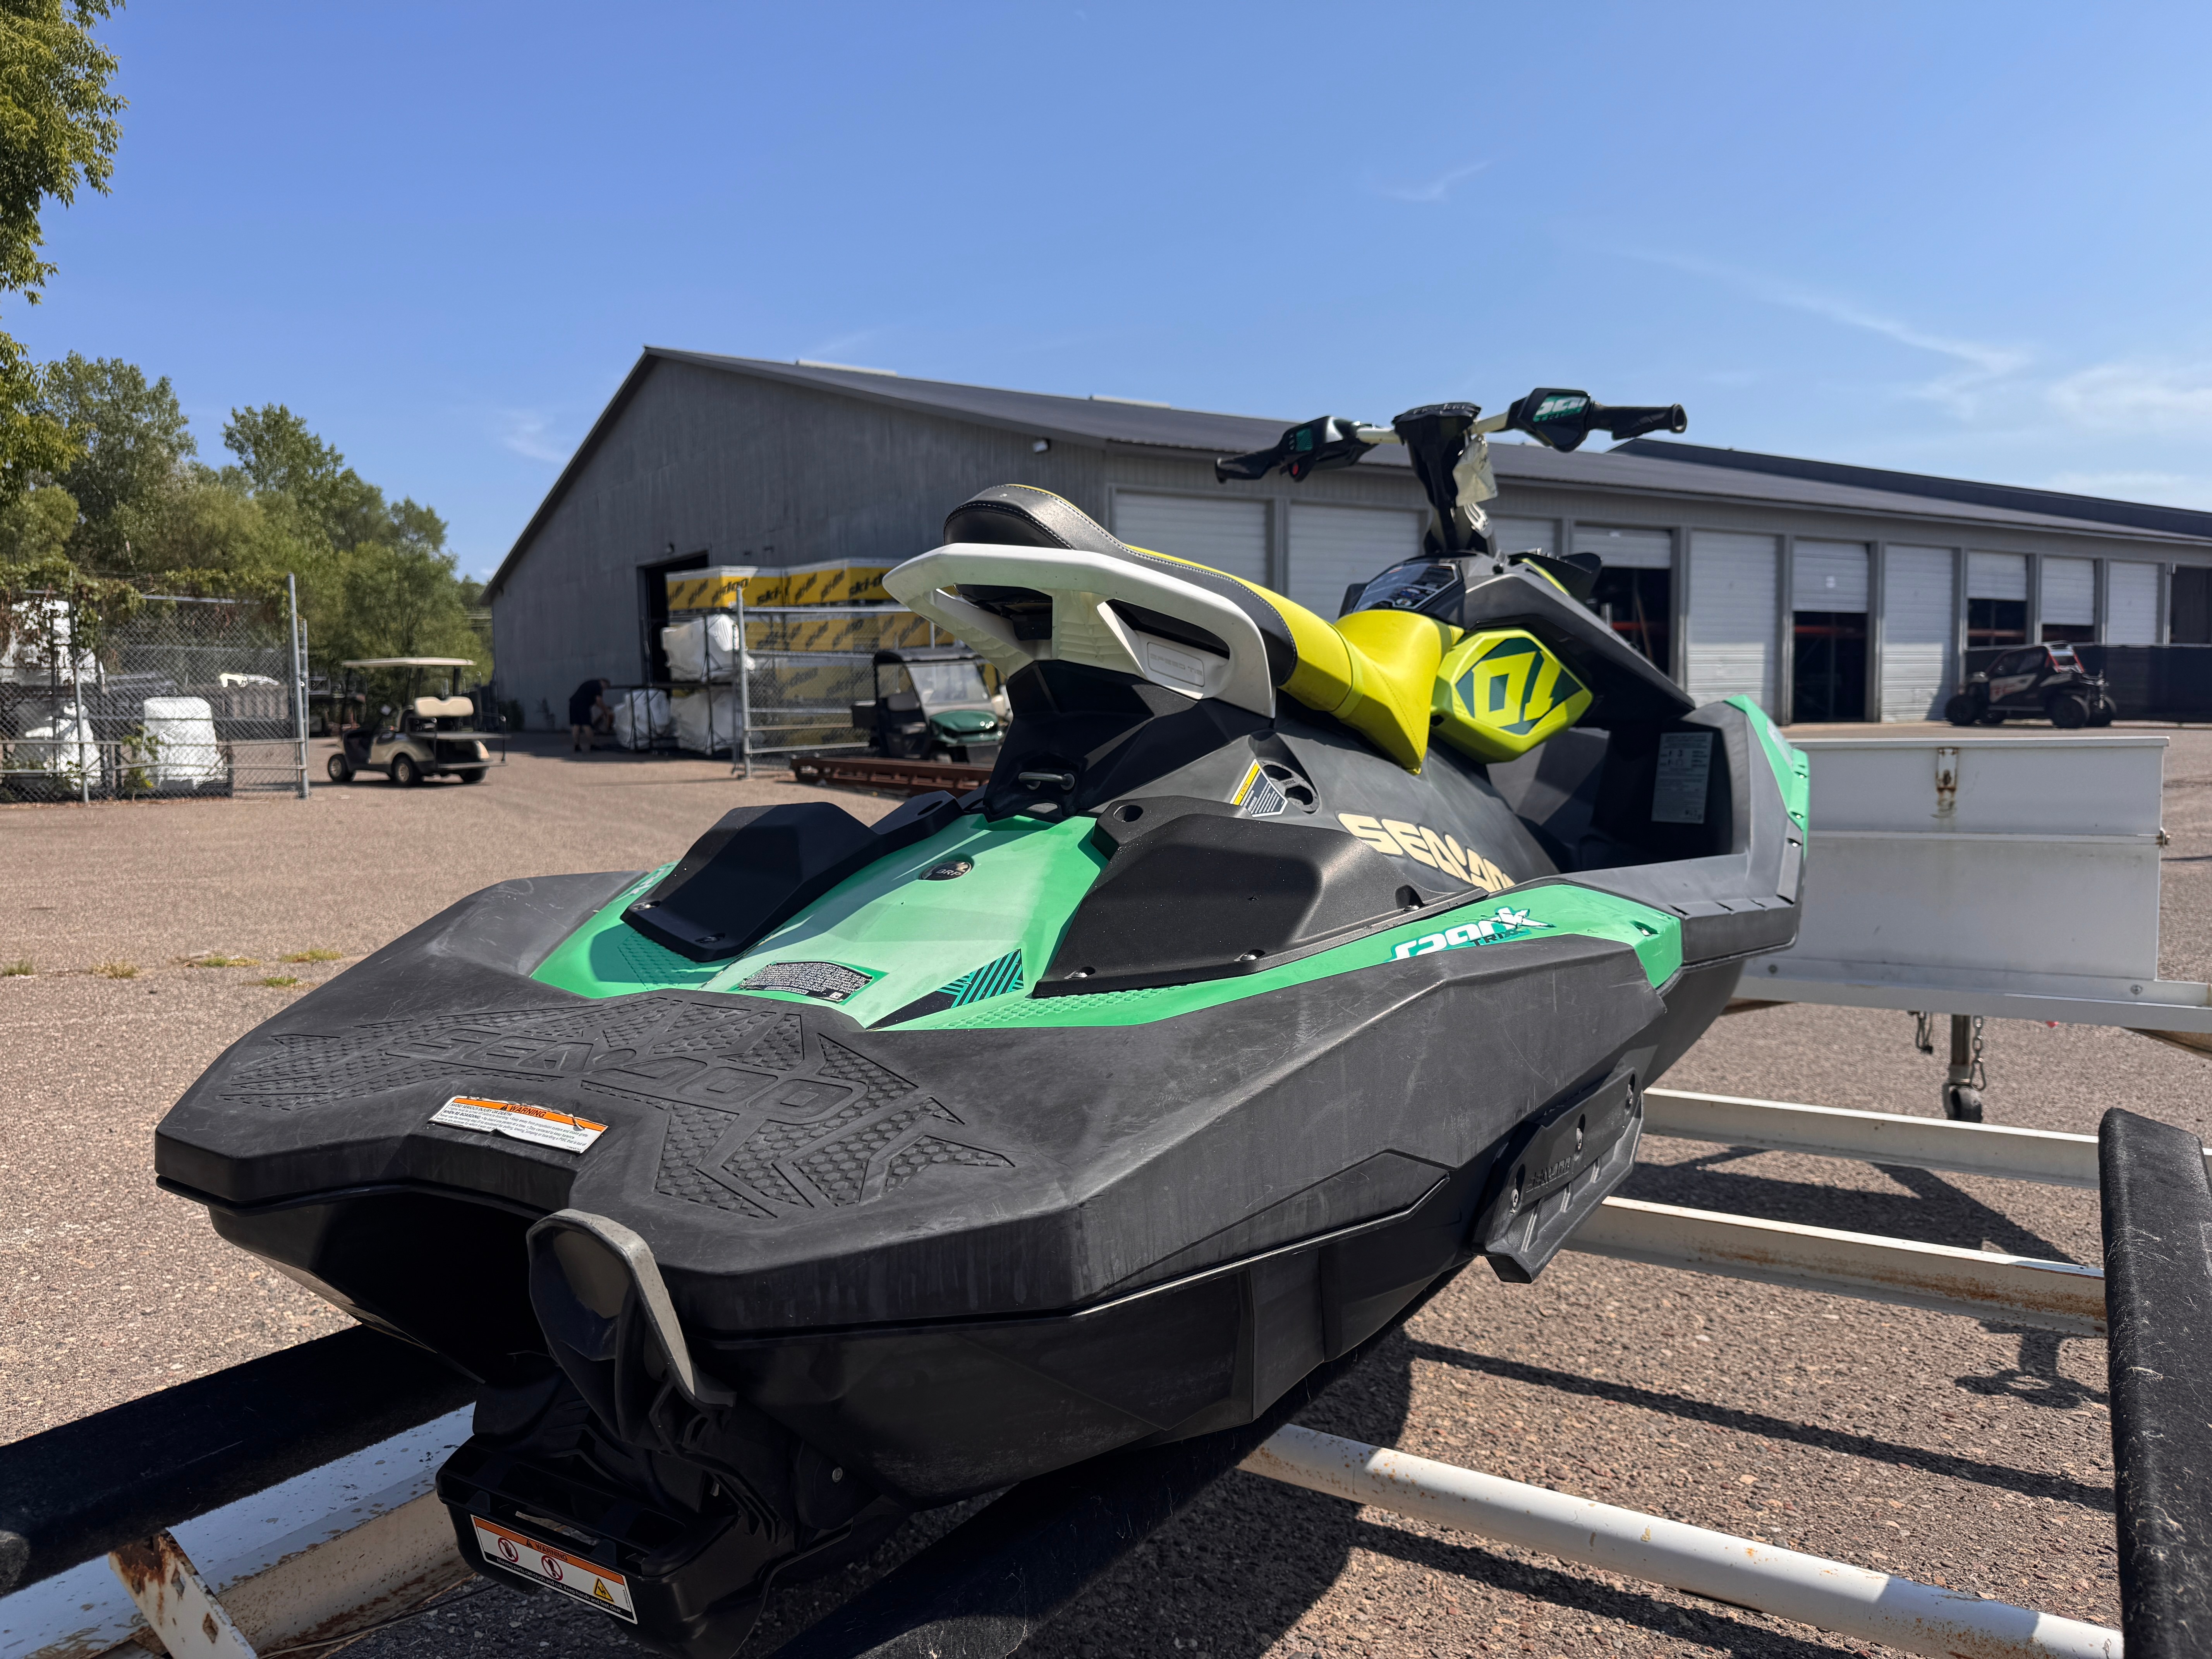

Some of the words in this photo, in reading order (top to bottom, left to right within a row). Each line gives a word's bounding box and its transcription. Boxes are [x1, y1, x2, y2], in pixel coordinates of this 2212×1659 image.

[509, 1105, 547, 1117] WARNING
[536, 1543, 568, 1561] WARNING
[497, 1558, 513, 1569] Moving
[513, 1565, 524, 1574] parts
[533, 1573, 545, 1582] crush
[564, 1585, 575, 1595] Keep
[576, 1590, 589, 1600] hands
